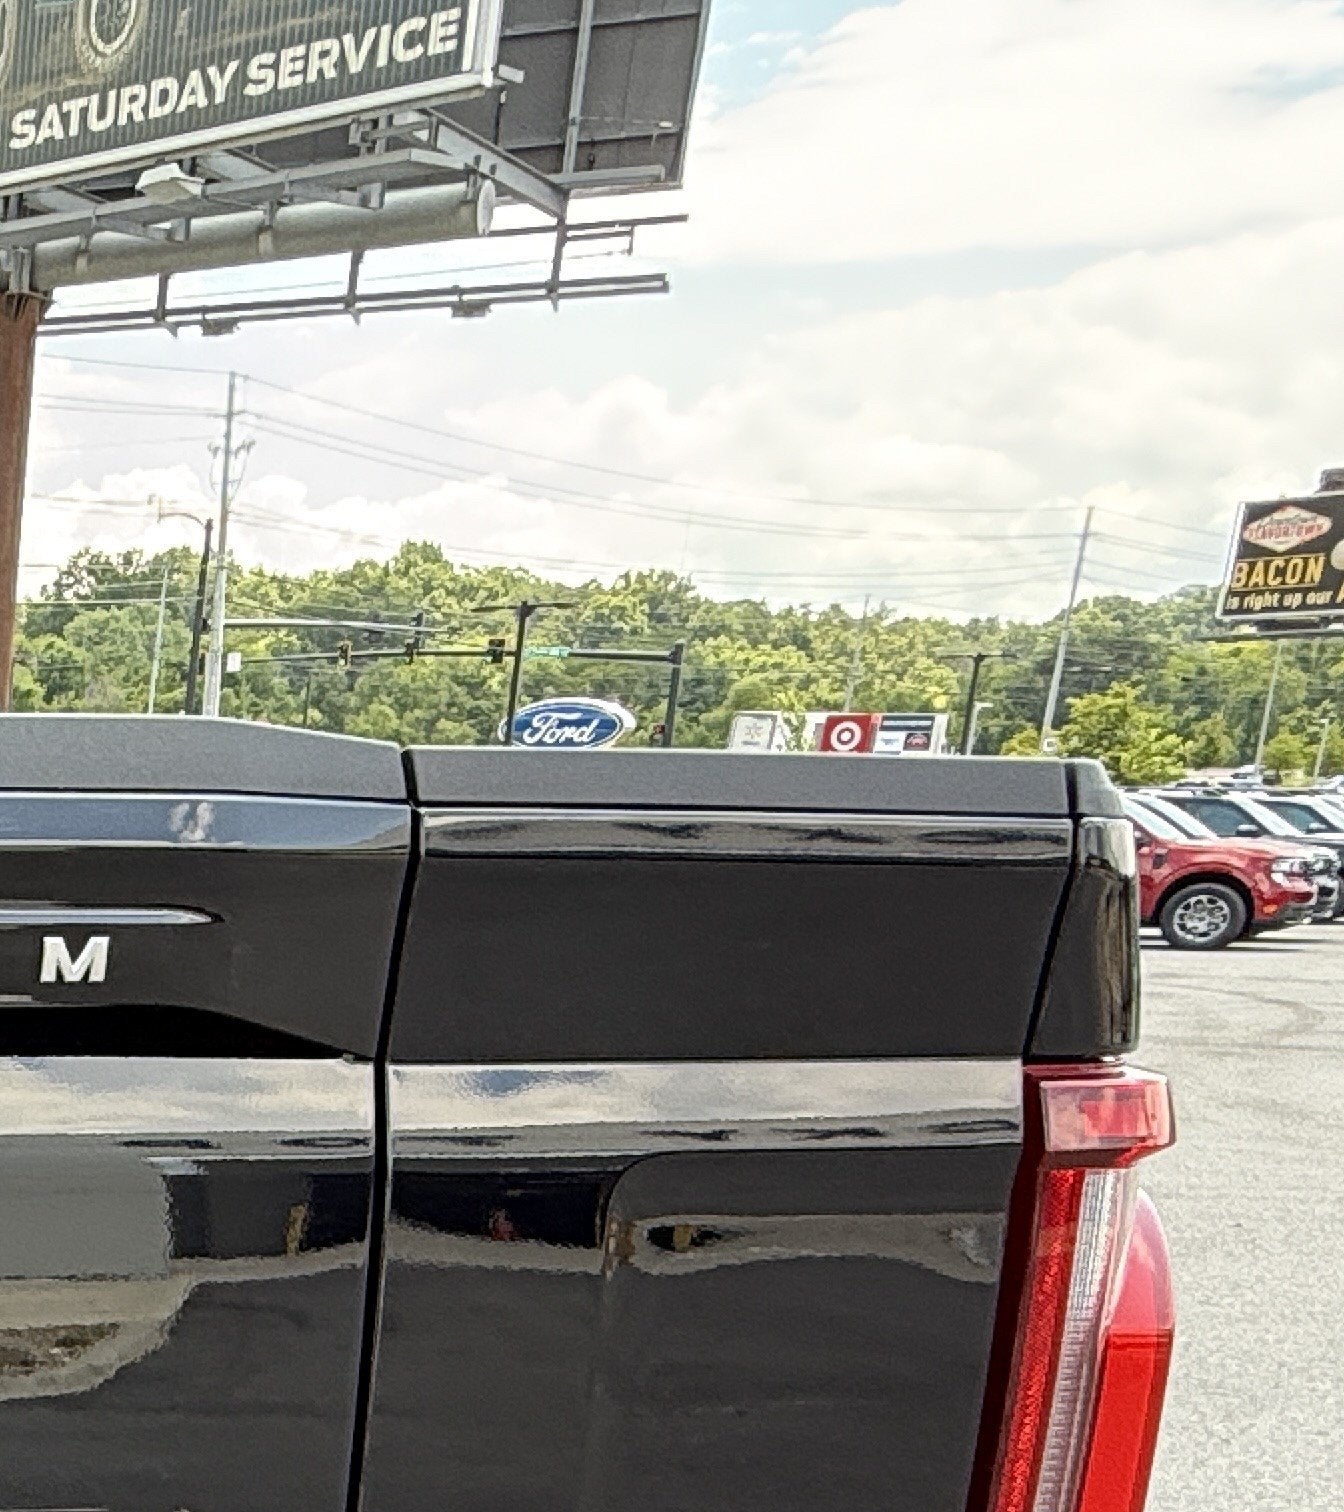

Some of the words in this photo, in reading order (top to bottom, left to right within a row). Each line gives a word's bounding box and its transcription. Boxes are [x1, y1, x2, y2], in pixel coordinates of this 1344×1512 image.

[9, 59, 240, 150] SATURDAY
[243, 7, 462, 97] SERVICE
[1231, 556, 1325, 587] BACON
[1243, 591, 1281, 611] right
[1283, 593, 1304, 609] up
[1306, 591, 1334, 605] our
[523, 712, 600, 743] Ford
